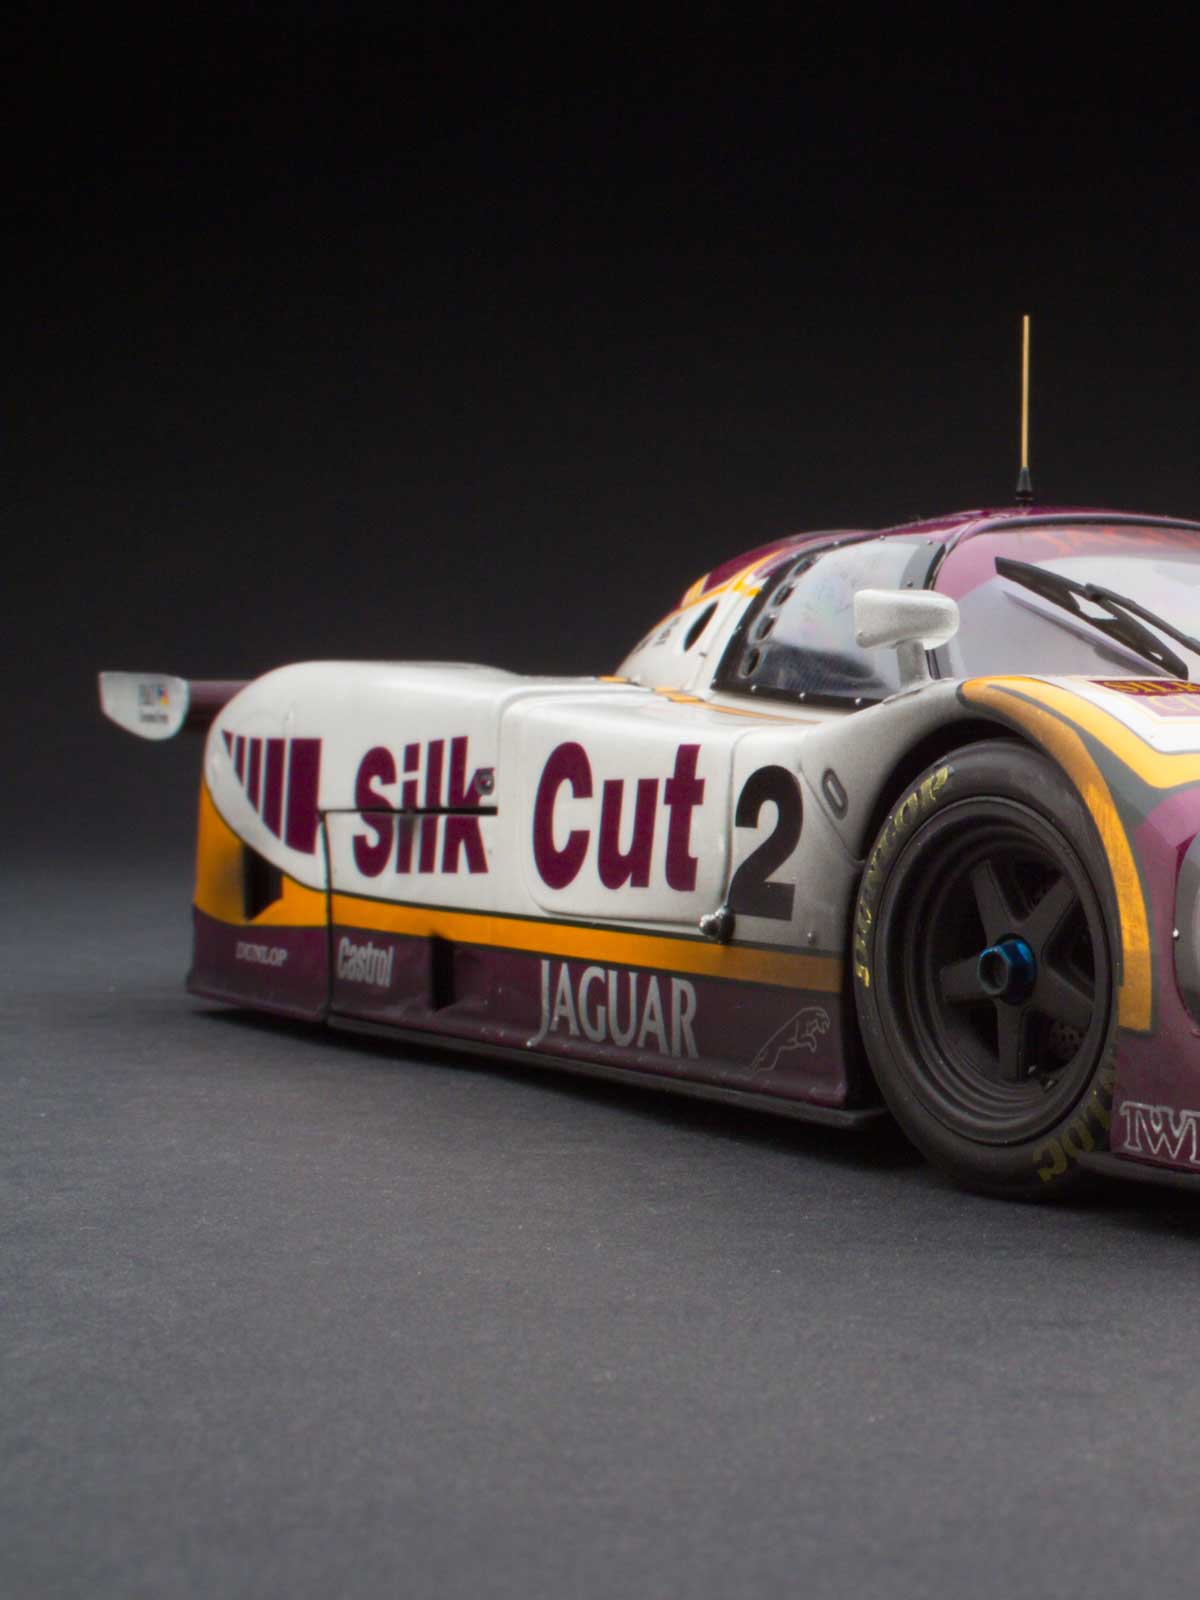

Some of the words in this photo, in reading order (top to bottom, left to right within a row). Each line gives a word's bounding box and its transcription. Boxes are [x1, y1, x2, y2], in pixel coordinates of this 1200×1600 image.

[352, 735, 495, 878] Silk
[533, 741, 705, 892] Cut
[732, 764, 803, 922] 2
[336, 936, 394, 986] Castrol
[527, 959, 697, 1060] JAGUAR
